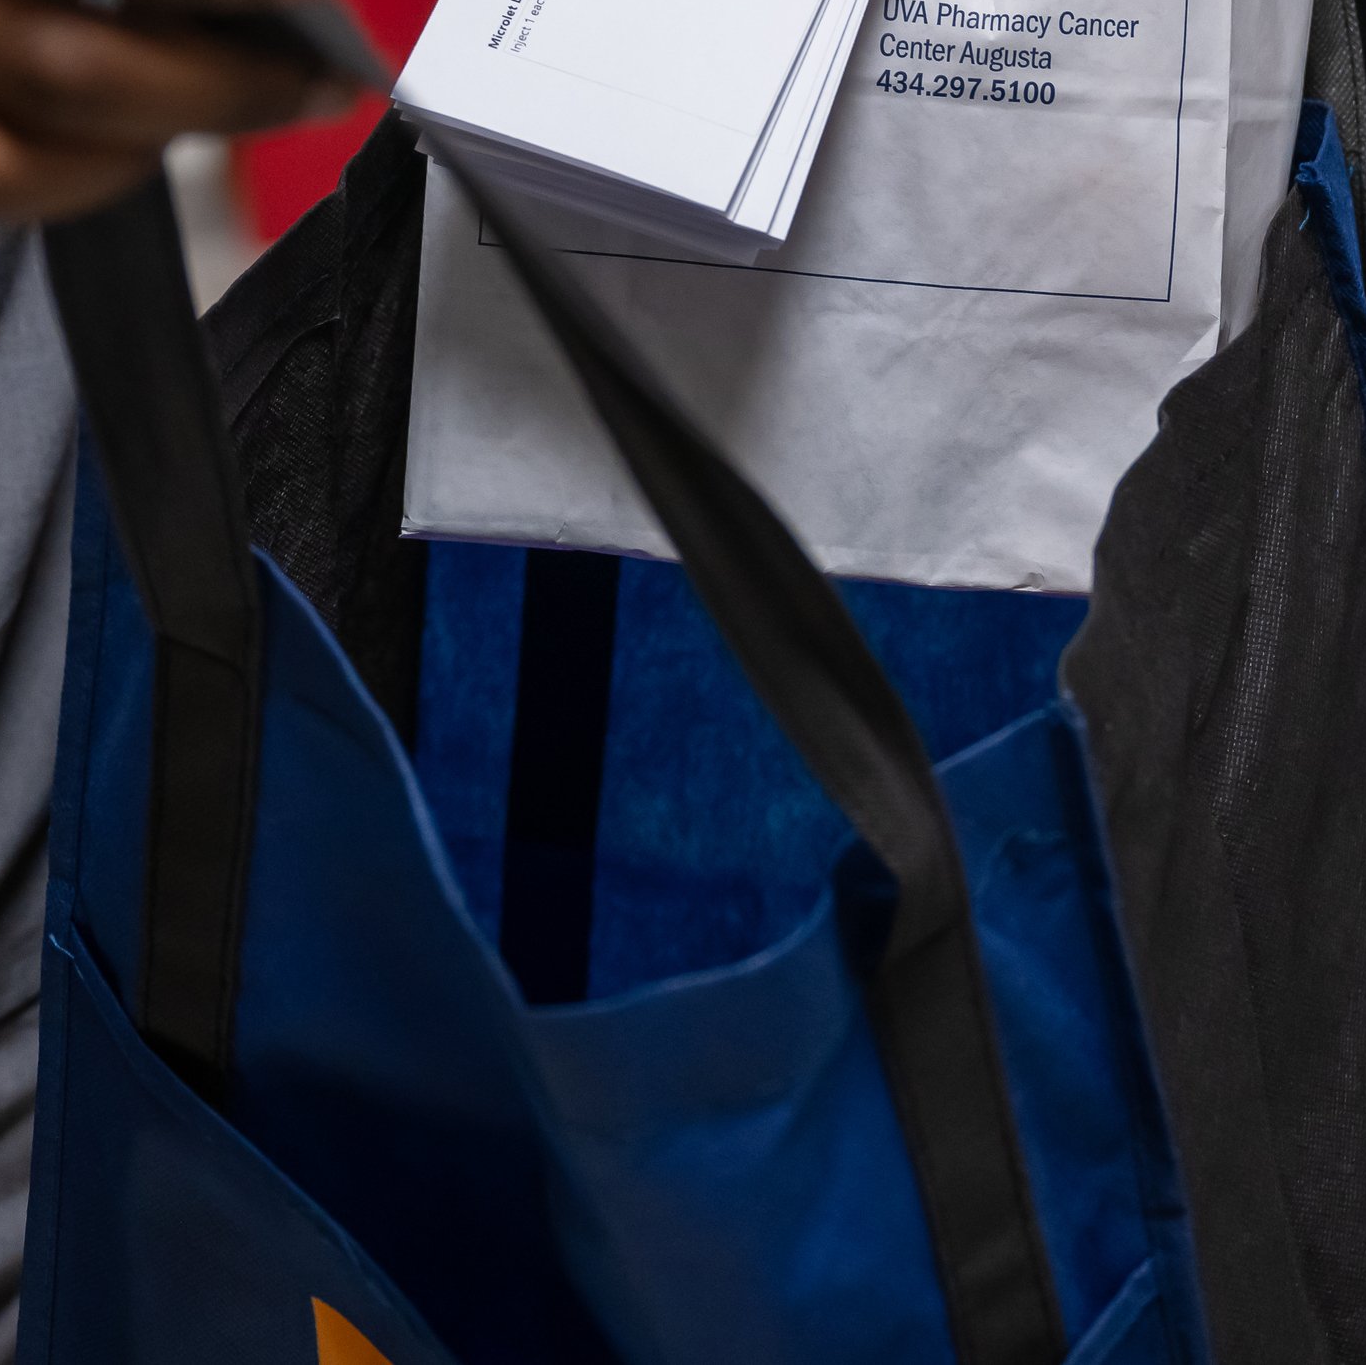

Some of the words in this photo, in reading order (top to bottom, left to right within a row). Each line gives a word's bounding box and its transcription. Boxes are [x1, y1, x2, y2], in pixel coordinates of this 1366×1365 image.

[488, 5, 519, 50] Microlet
[936, 2, 1051, 39] Pharmacy
[1059, 11, 1139, 39] Cancer
[510, 25, 533, 54] Inject
[879, 32, 956, 63] Center
[959, 41, 1052, 72] Augusta
[876, 69, 1056, 105] 434.297.5100
